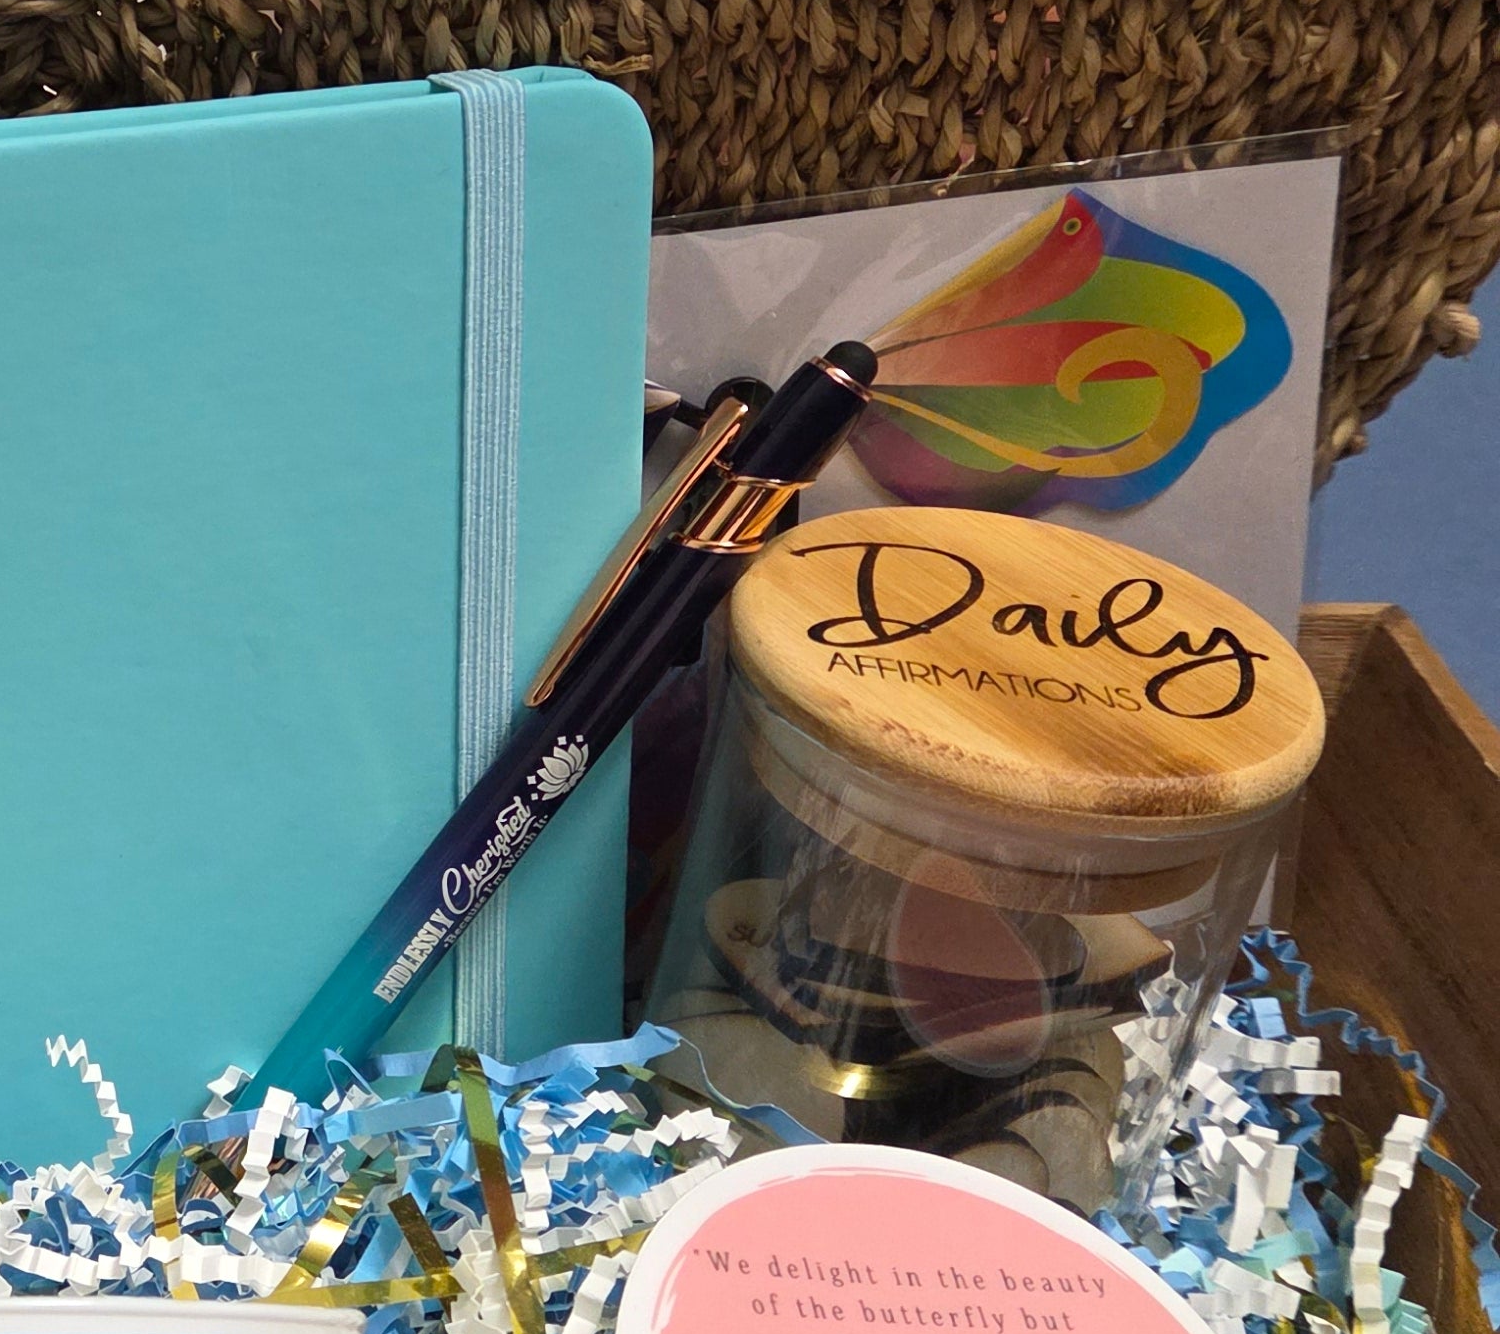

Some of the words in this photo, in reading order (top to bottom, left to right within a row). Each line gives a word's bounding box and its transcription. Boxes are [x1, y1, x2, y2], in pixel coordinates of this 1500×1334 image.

[790, 542, 1269, 719] Daily
[827, 651, 1142, 713] AFFIRMATIONS
[483, 872, 505, 896] I'm
[502, 832, 537, 869] Worth
[372, 907, 454, 1004] ENDLESSLY
[442, 795, 531, 915] Cherished
[768, 1256, 880, 1287] delight
[893, 1267, 923, 1288] in
[937, 1268, 986, 1291] the
[1002, 1268, 1106, 1298] beauty
[751, 1293, 780, 1316] of
[796, 1297, 845, 1322] the
[862, 1301, 1006, 1334] butterfly
[1024, 1307, 1075, 1332] but
